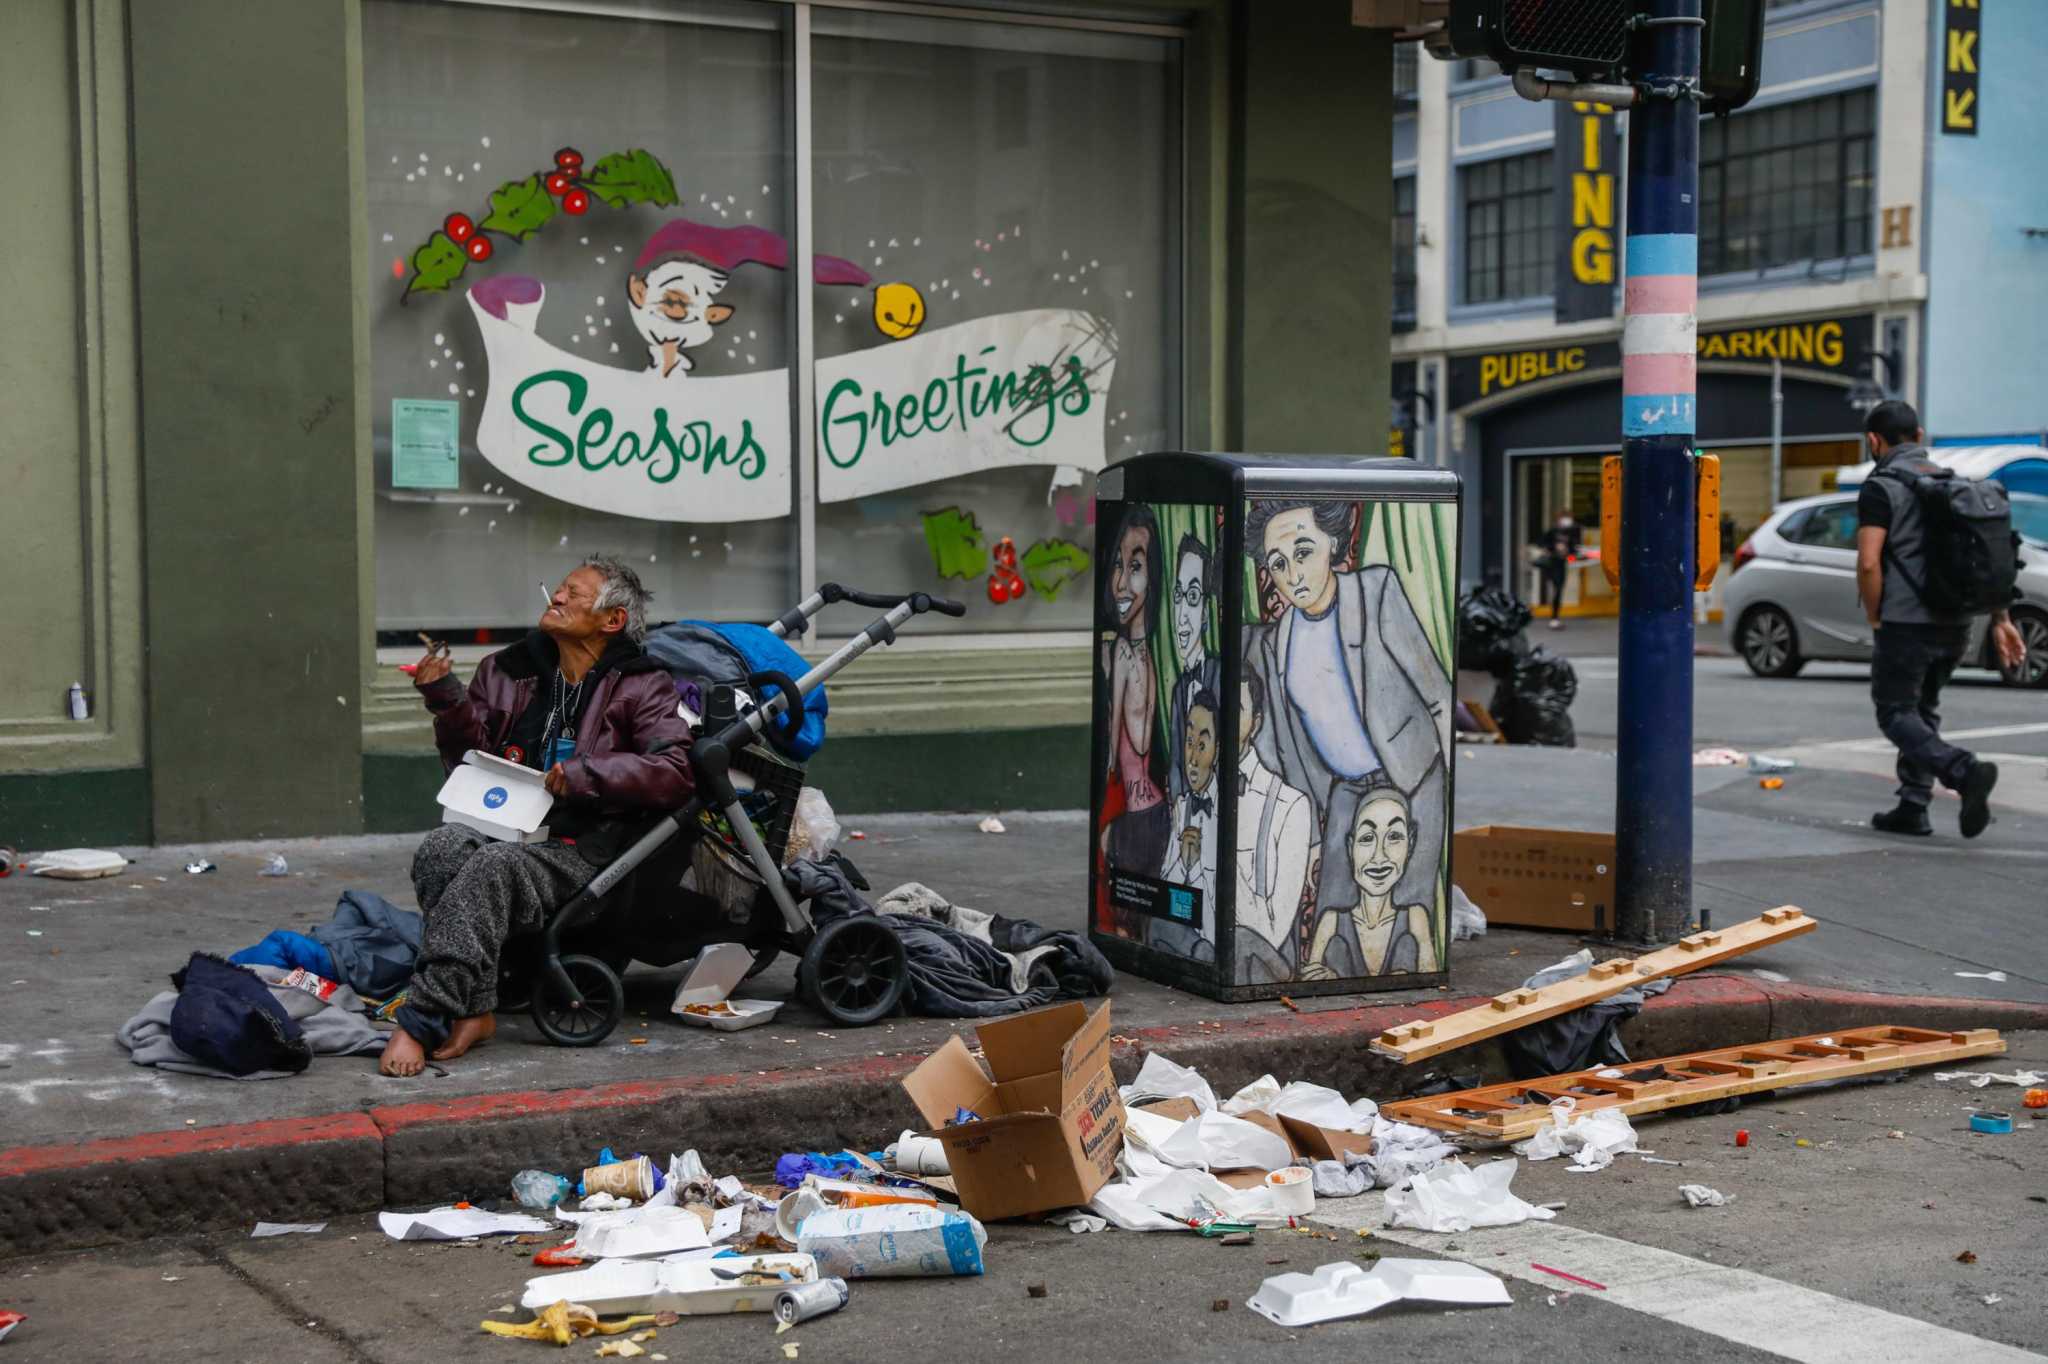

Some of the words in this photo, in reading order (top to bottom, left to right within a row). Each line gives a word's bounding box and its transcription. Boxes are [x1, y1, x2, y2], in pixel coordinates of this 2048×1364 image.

[1948, 0, 1978, 73] K
[1573, 101, 1614, 285] ING
[512, 369, 767, 484] Seasons
[822, 346, 1091, 469] Greetings
[1481, 347, 1586, 396] PUBLIC
